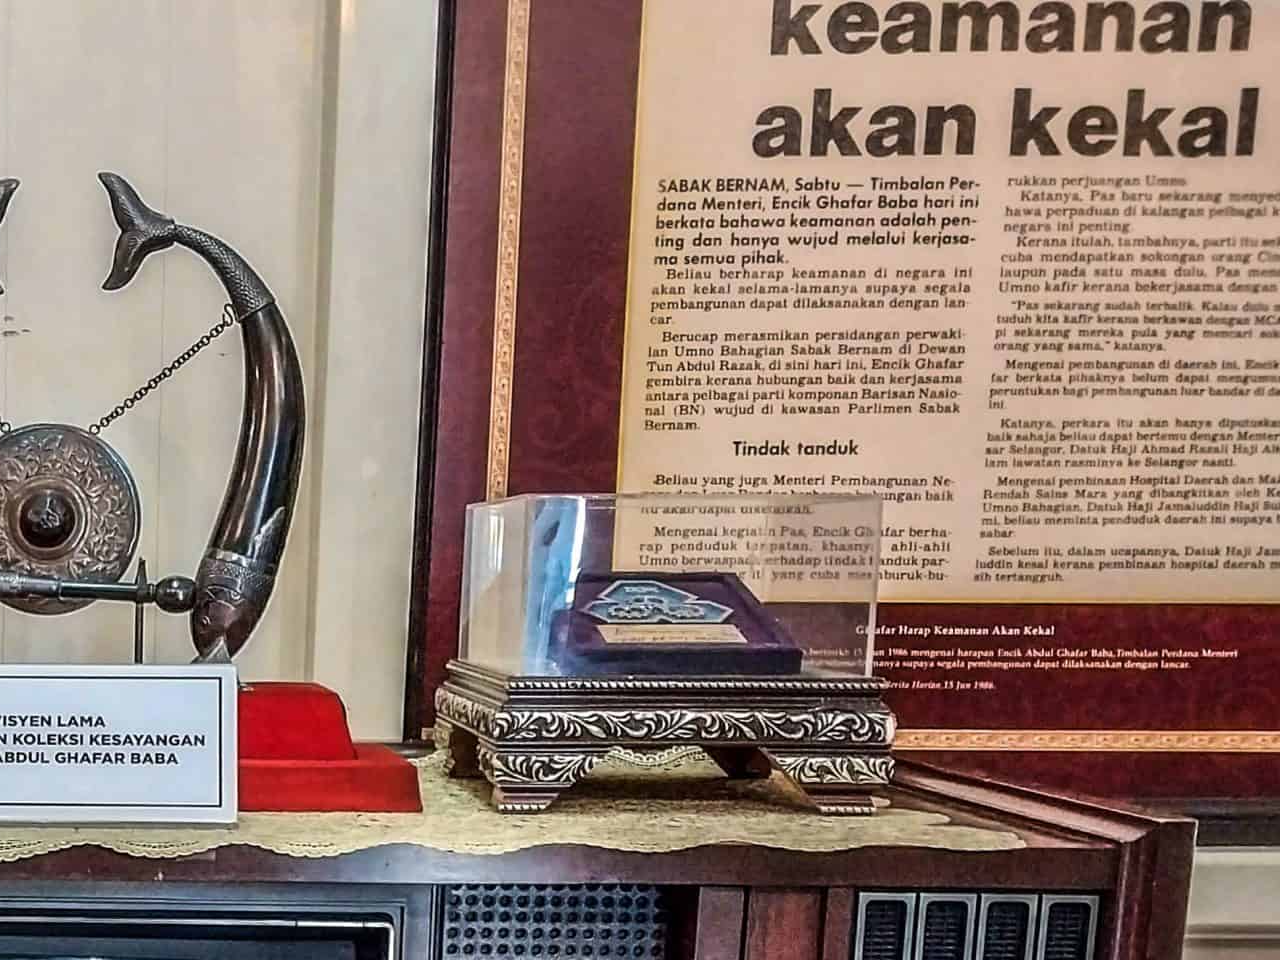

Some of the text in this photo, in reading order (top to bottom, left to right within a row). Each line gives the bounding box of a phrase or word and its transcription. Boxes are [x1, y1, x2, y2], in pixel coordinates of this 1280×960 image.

[770, 0, 1252, 55] keamanan
[752, 87, 1260, 157] akan kekal
[658, 177, 981, 194] SABAK BERNAM, Sabtu Timbalan Per-
[657, 194, 979, 212] dana Menteri, Encik Ghafar Baba hari ini
[656, 213, 976, 230] berkata bahawa keamanan adalah pen-
[655, 231, 976, 251] ting dan hanya wujud melalui kerjasa-
[654, 250, 789, 268] ma semua pihak.
[666, 267, 972, 283] Beliau berharap keamanan di negara ini
[651, 282, 970, 298] akan kekal selama-lamanya supaya segala
[651, 297, 745, 313] pembangunan
[749, 297, 787, 313] dapat
[793, 297, 884, 309] dilaksanakan
[888, 297, 939, 312] dengan
[662, 330, 718, 346] Berucap
[724, 329, 808, 342] merasmikan
[815, 328, 899, 344] persidangan
[648, 343, 965, 360] lan Umno Bahagian Sabak Bernam di Dewan
[646, 360, 672, 372] Tun
[676, 360, 715, 372] Abdul
[768, 359, 781, 371] di
[784, 359, 809, 371] sini
[813, 359, 841, 371] hari
[871, 358, 910, 370] Encik
[914, 358, 964, 370] Ghafar
[646, 373, 962, 390] gembira kerana hubungan baik dan kerjasama
[645, 389, 688, 401] antara
[692, 389, 748, 404] pelbagai
[752, 388, 784, 404] parti
[861, 387, 915, 400] Barisan
[917, 387, 960, 399] Nasio-
[644, 401, 960, 419] nal (BN) wujud di kawasan Parlimen Sabak
[733, 440, 858, 457] Tindak tanduk
[656, 474, 955, 490] Beliau yang juga Menteri Pembangunan Ne-
[925, 489, 953, 501] baik
[856, 625, 1055, 637] Gafar Harap Keamanan Akan Kekal
[57, 716, 105, 729] LAMA
[12, 733, 83, 746] KOLEKSI
[89, 734, 205, 747] KESAYANGAN
[54, 752, 124, 765] GHAFAR
[130, 752, 178, 765] BABA
